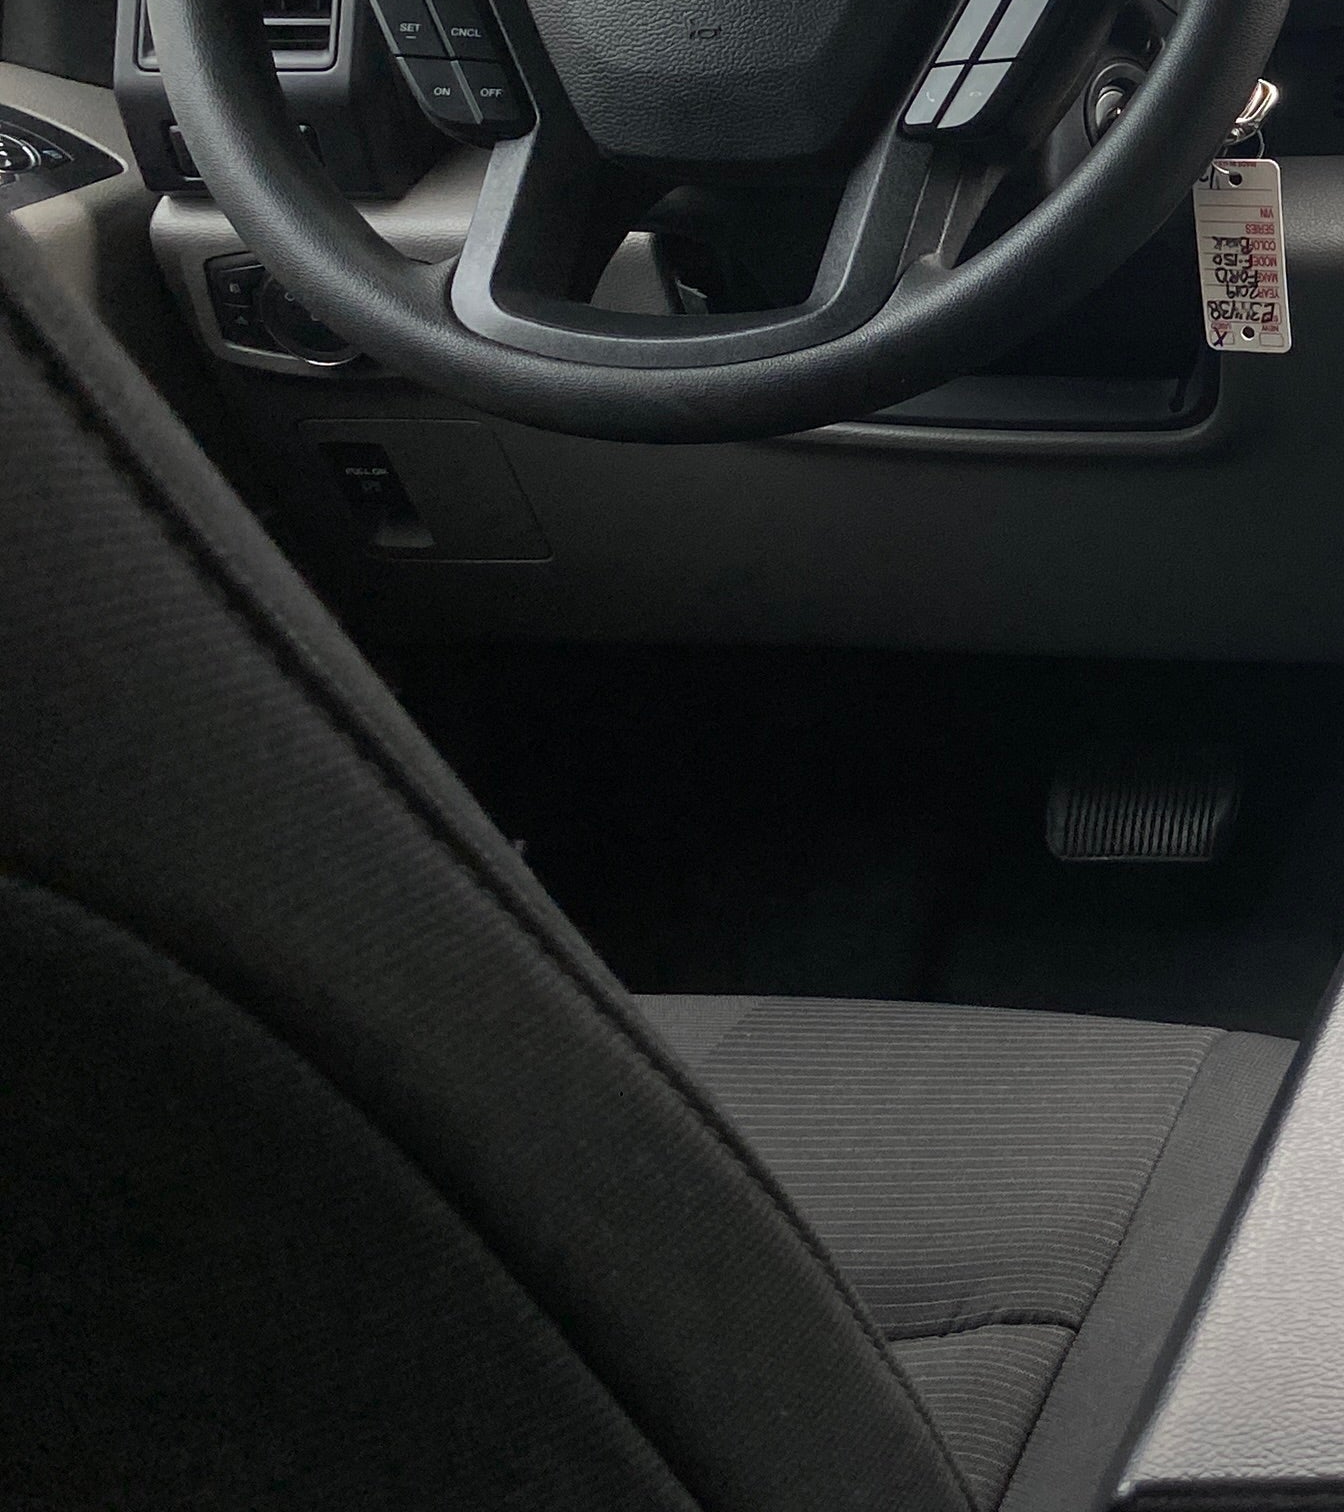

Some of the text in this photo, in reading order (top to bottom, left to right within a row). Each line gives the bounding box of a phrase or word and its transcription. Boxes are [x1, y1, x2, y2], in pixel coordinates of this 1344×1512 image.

[399, 23, 421, 33] SET
[451, 27, 482, 38] CNCL
[433, 87, 451, 97] ON
[480, 88, 503, 98] OFF
[1260, 207, 1274, 218] VIN
[1245, 224, 1275, 235] SERIES
[1251, 256, 1278, 267] MODE
[1215, 267, 1259, 287] FORD
